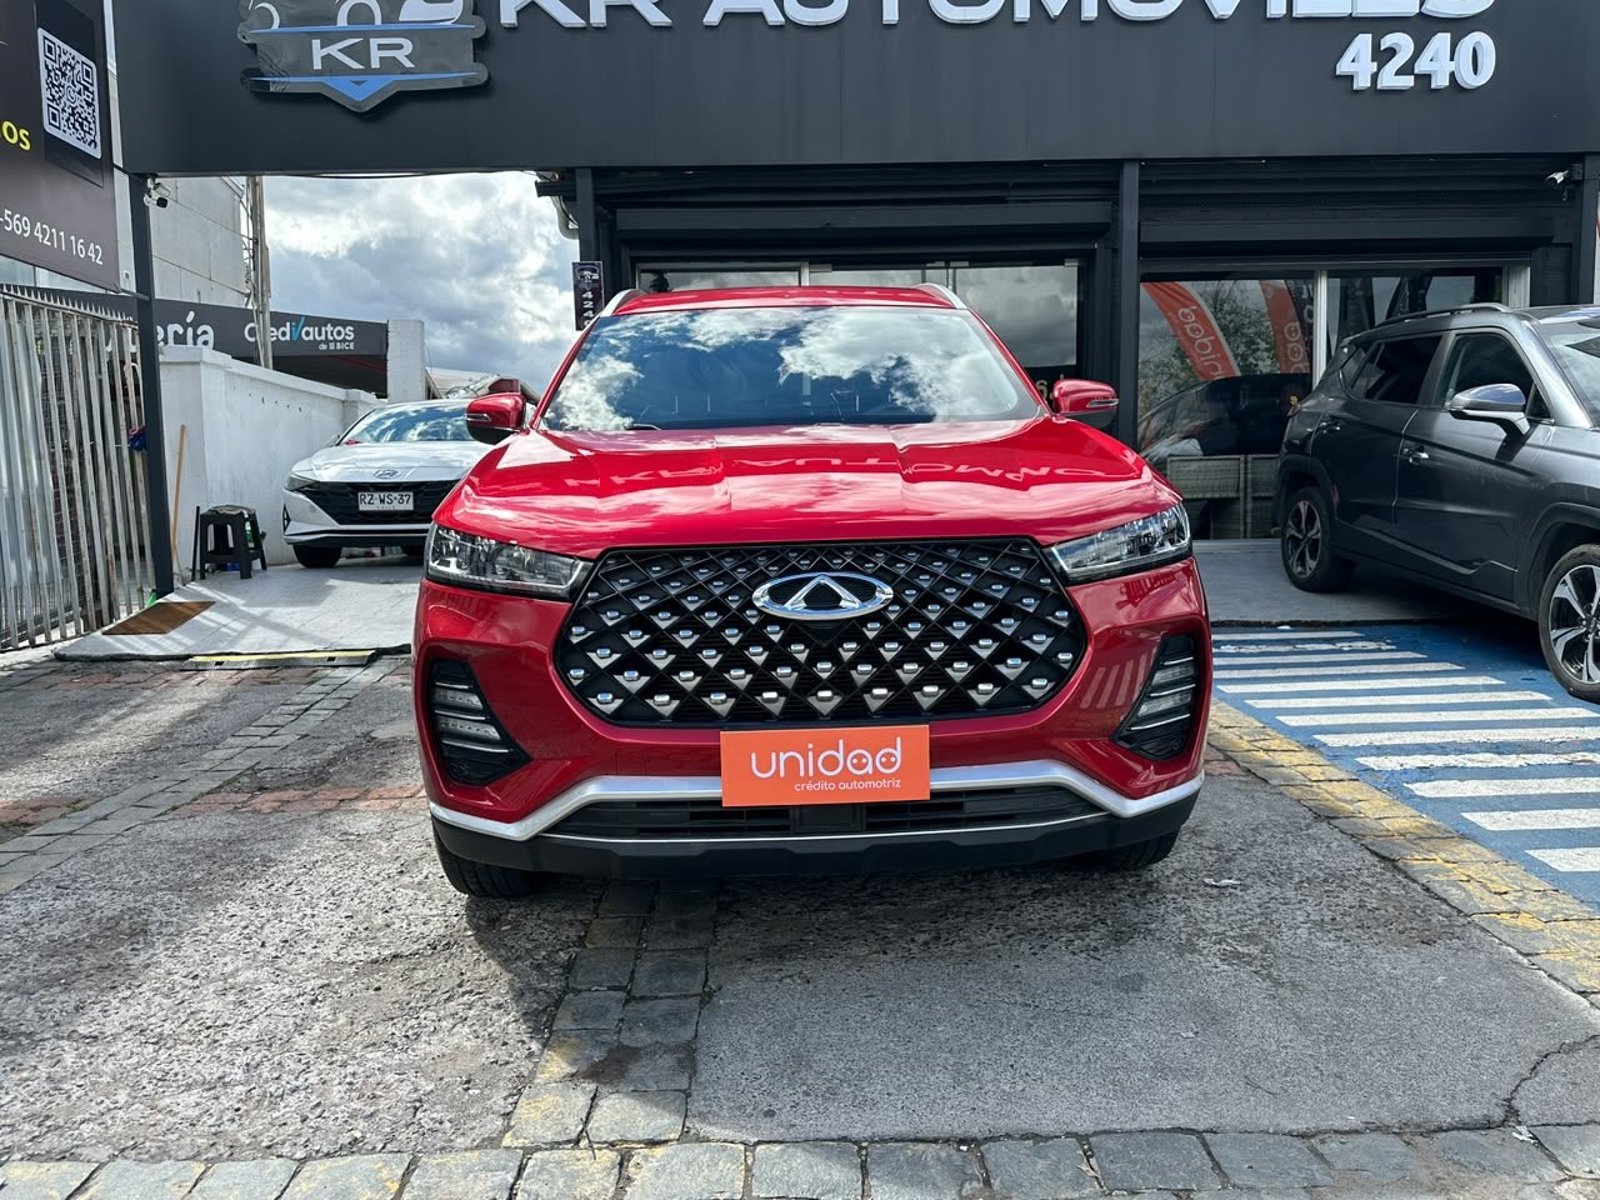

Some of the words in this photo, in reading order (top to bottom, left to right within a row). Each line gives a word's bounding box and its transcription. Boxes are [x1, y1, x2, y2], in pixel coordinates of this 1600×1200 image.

[311, 37, 416, 70] KR
[1336, 31, 1496, 90] 4240
[33, 221, 67, 252] 4211
[751, 737, 901, 778] unidad
[794, 779, 836, 792] crédito
[838, 778, 901, 790] automotriz
